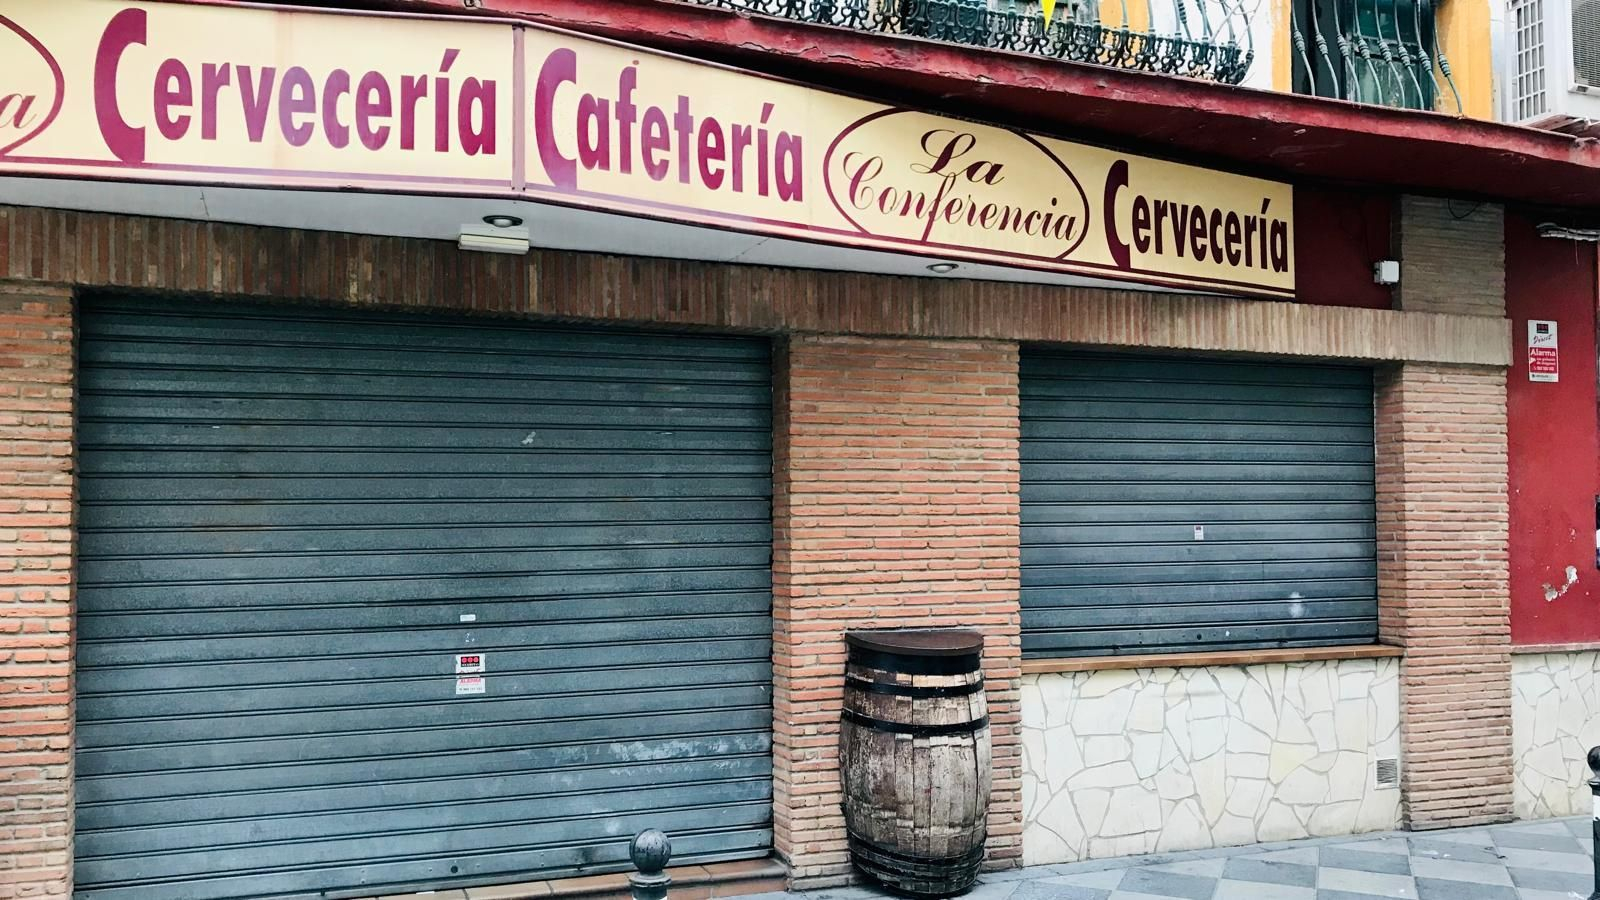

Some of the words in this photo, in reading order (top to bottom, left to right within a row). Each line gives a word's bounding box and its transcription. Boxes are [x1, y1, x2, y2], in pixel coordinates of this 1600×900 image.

[94, 7, 497, 163] Cervecería
[534, 47, 804, 202] Cafetería
[842, 151, 1078, 242] Conferencia
[909, 128, 1006, 186] La
[1103, 159, 1289, 273] Cervecería
[1530, 348, 1556, 357] Alarma
